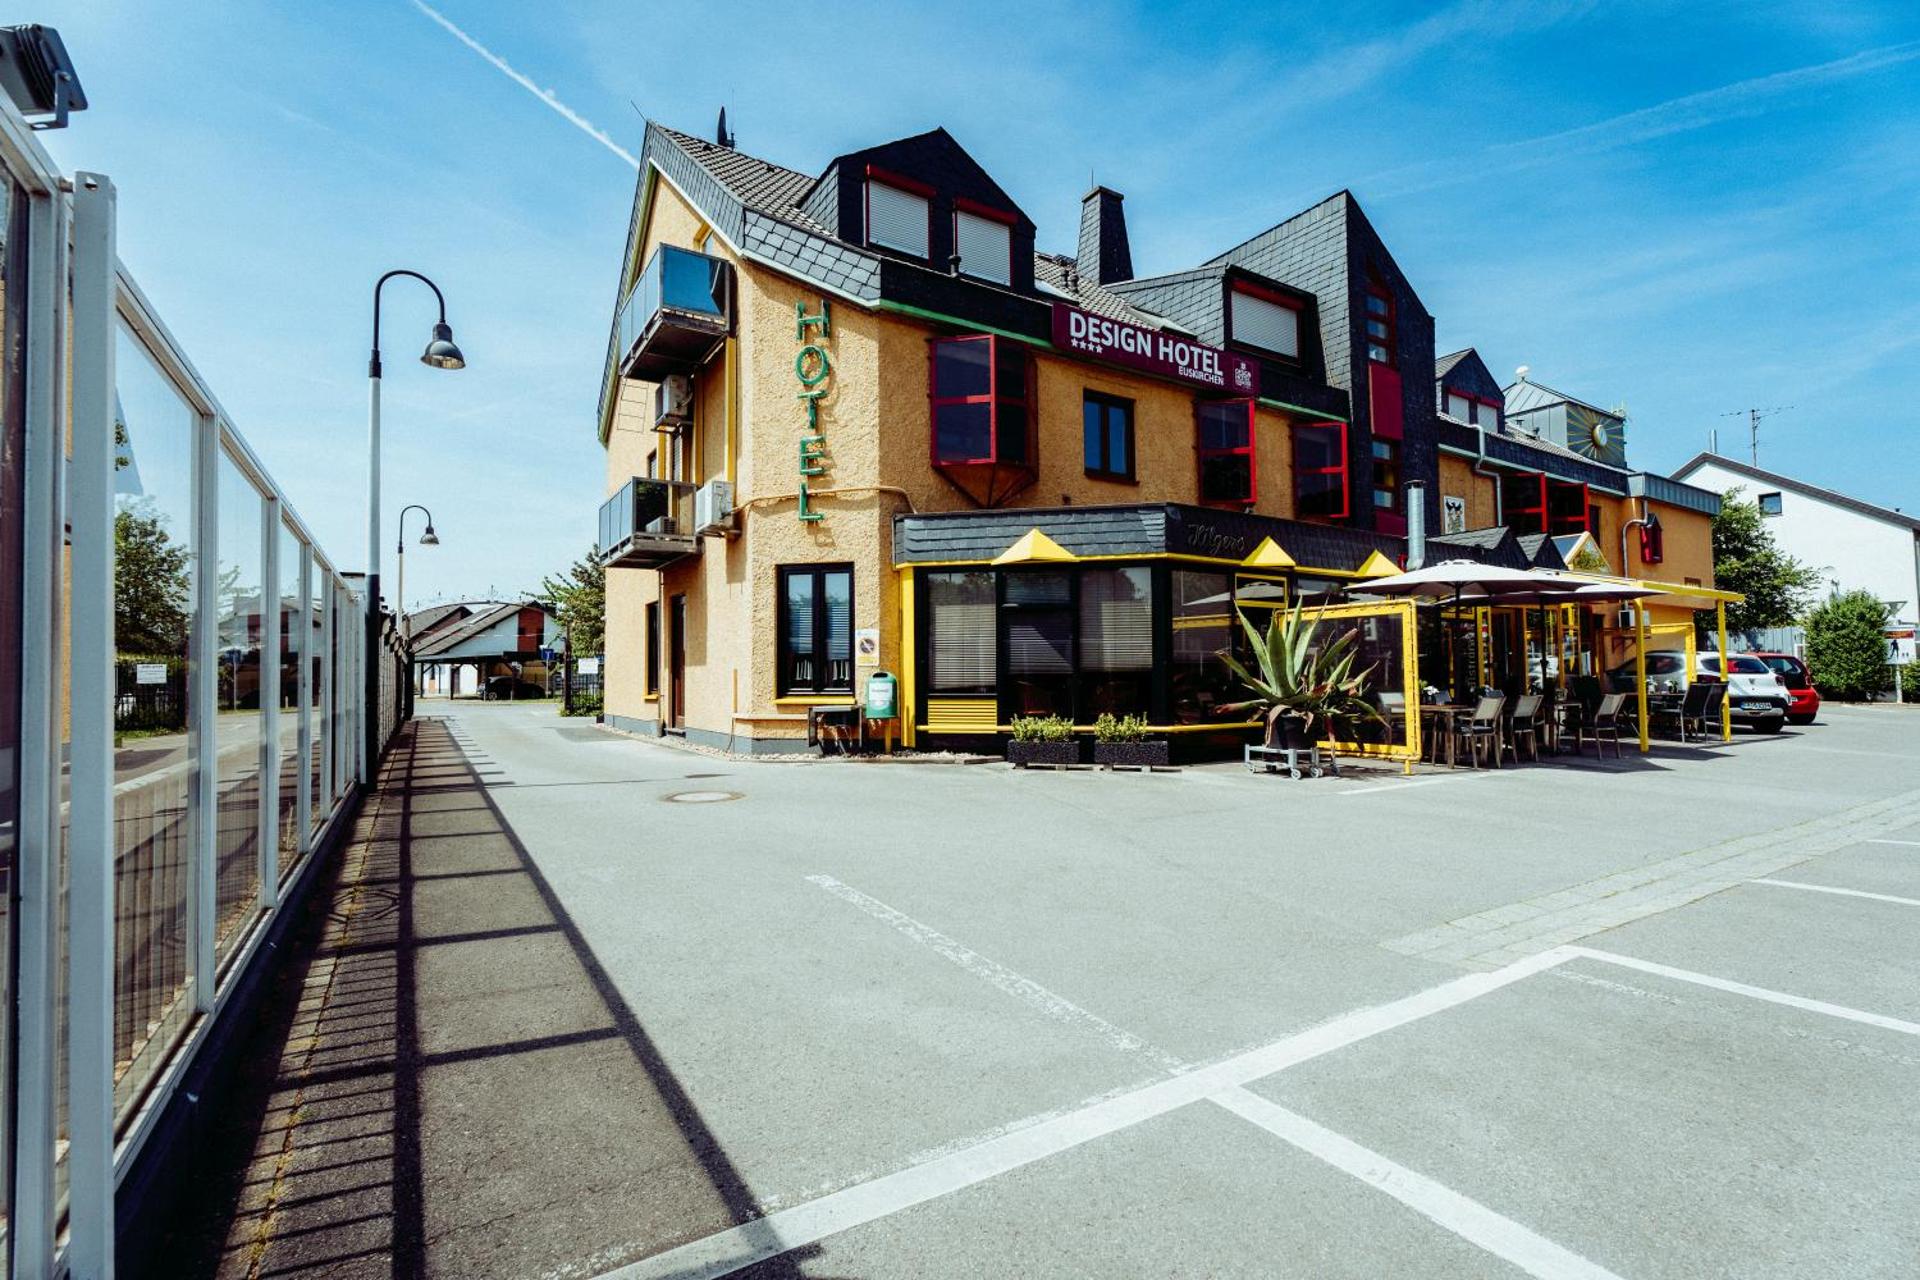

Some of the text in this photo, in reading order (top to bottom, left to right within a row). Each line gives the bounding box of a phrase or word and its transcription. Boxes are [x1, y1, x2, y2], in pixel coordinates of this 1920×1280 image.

[1069, 311, 1223, 377] DESIGN HOTEL
[1178, 365, 1225, 386] EUSKIRCHEN
[795, 300, 830, 521] HOTEL
